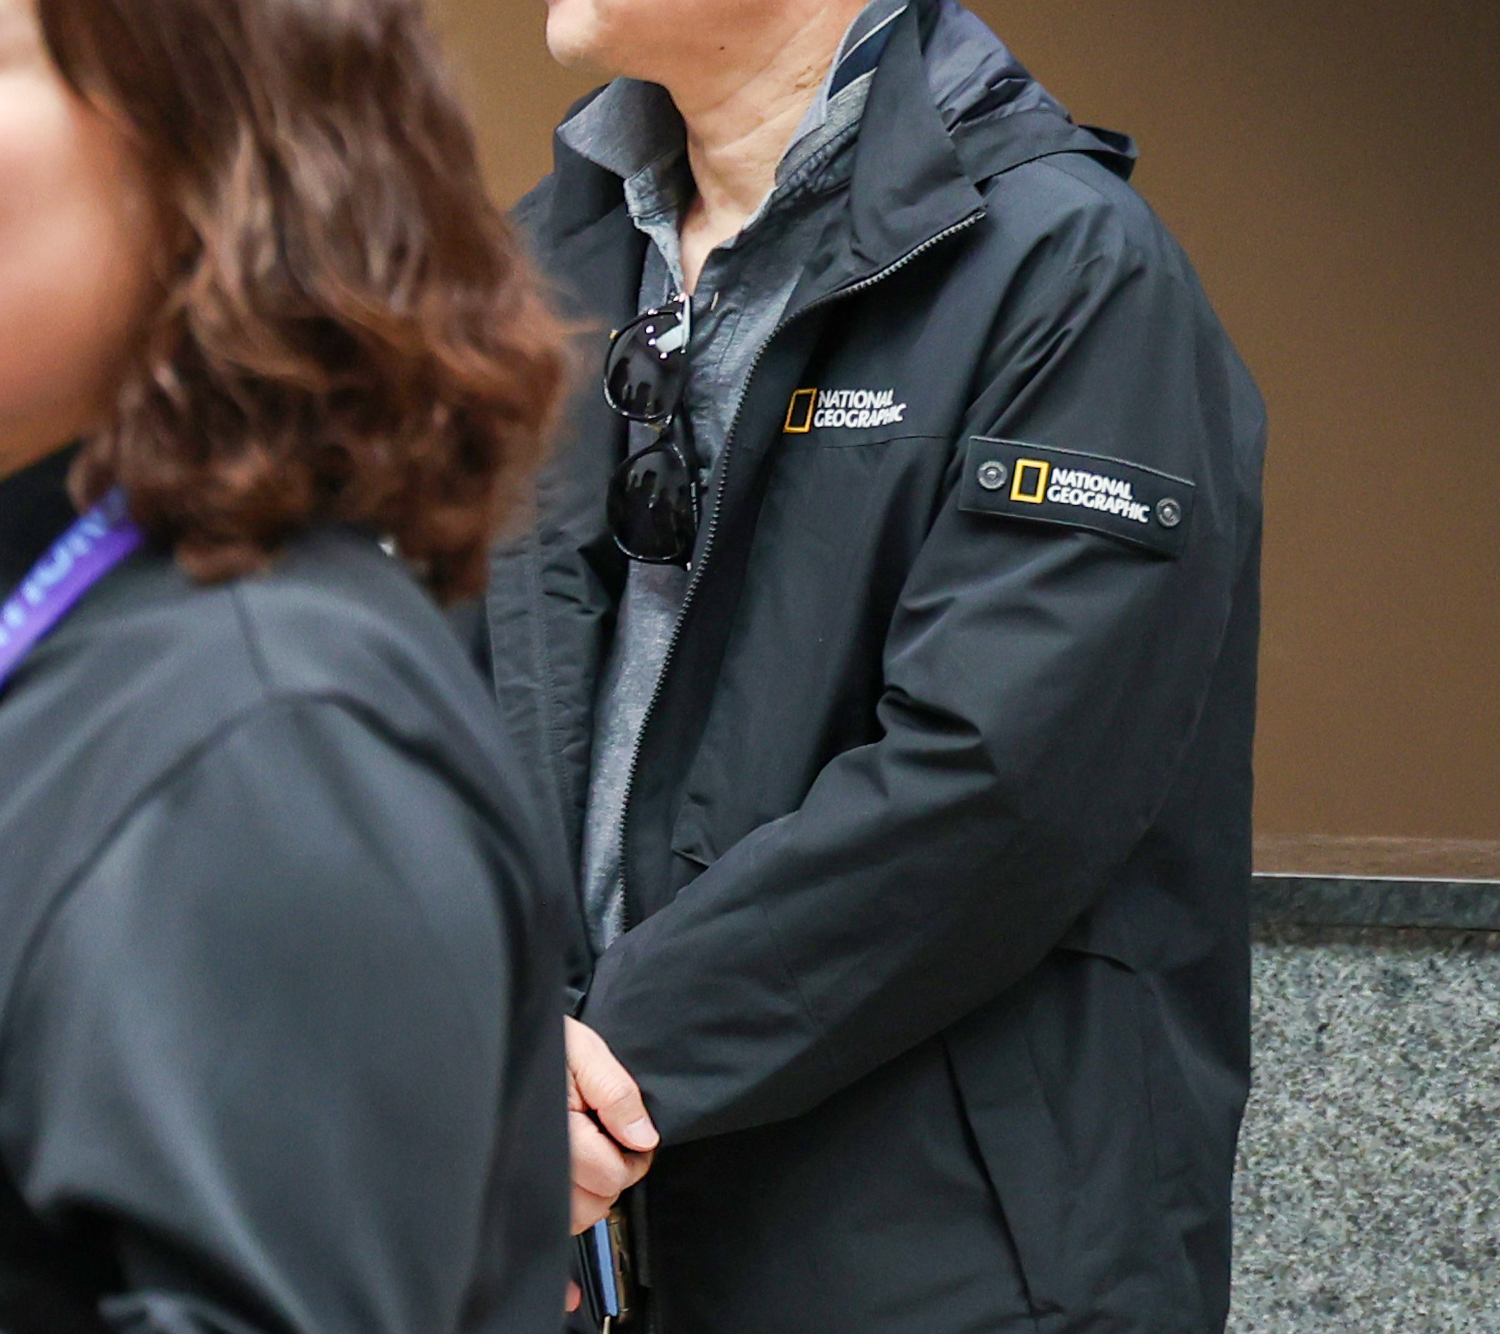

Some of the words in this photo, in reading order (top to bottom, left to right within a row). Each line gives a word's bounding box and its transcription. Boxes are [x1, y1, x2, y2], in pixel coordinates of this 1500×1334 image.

[816, 388, 894, 409] NATIONAL
[813, 403, 907, 430] GEOGRAPHIC
[1050, 468, 1133, 500] NATIONAL
[1046, 487, 1150, 523] GEOGRAPHIC
